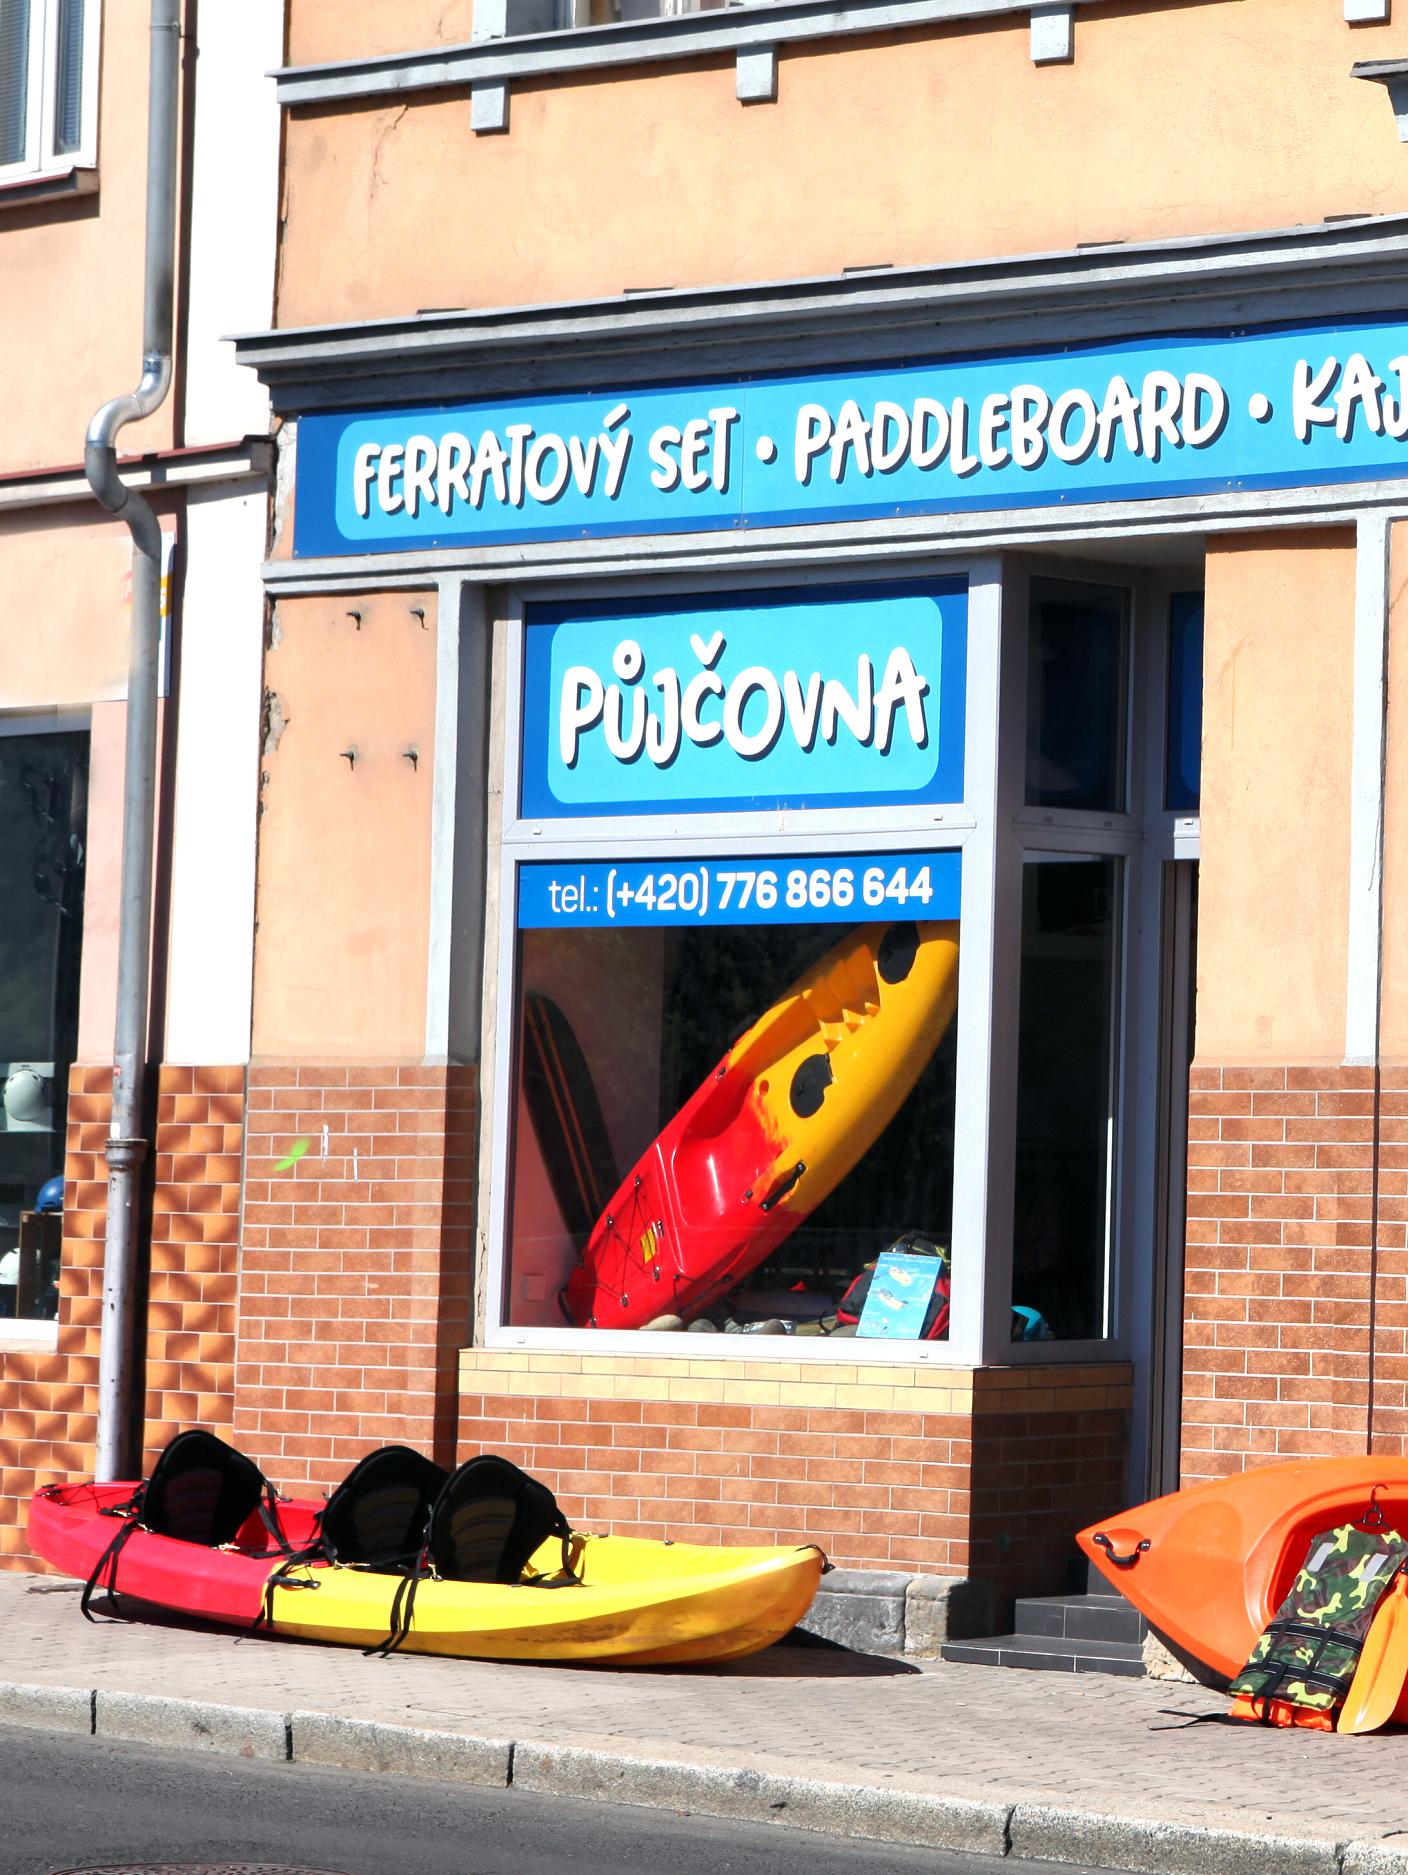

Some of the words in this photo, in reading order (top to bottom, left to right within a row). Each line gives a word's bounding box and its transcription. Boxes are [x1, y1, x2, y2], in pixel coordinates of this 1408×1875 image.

[353, 403, 630, 516] FERRATOVÝ
[648, 406, 737, 491] SET
[794, 370, 1225, 483] PADDLEBOARD
[559, 630, 927, 764] PŮJČOVNA
[548, 875, 599, 913] tel.:
[607, 866, 709, 918] (+420)
[716, 870, 778, 909] 776
[785, 868, 854, 908] 866
[862, 866, 933, 906] 644
